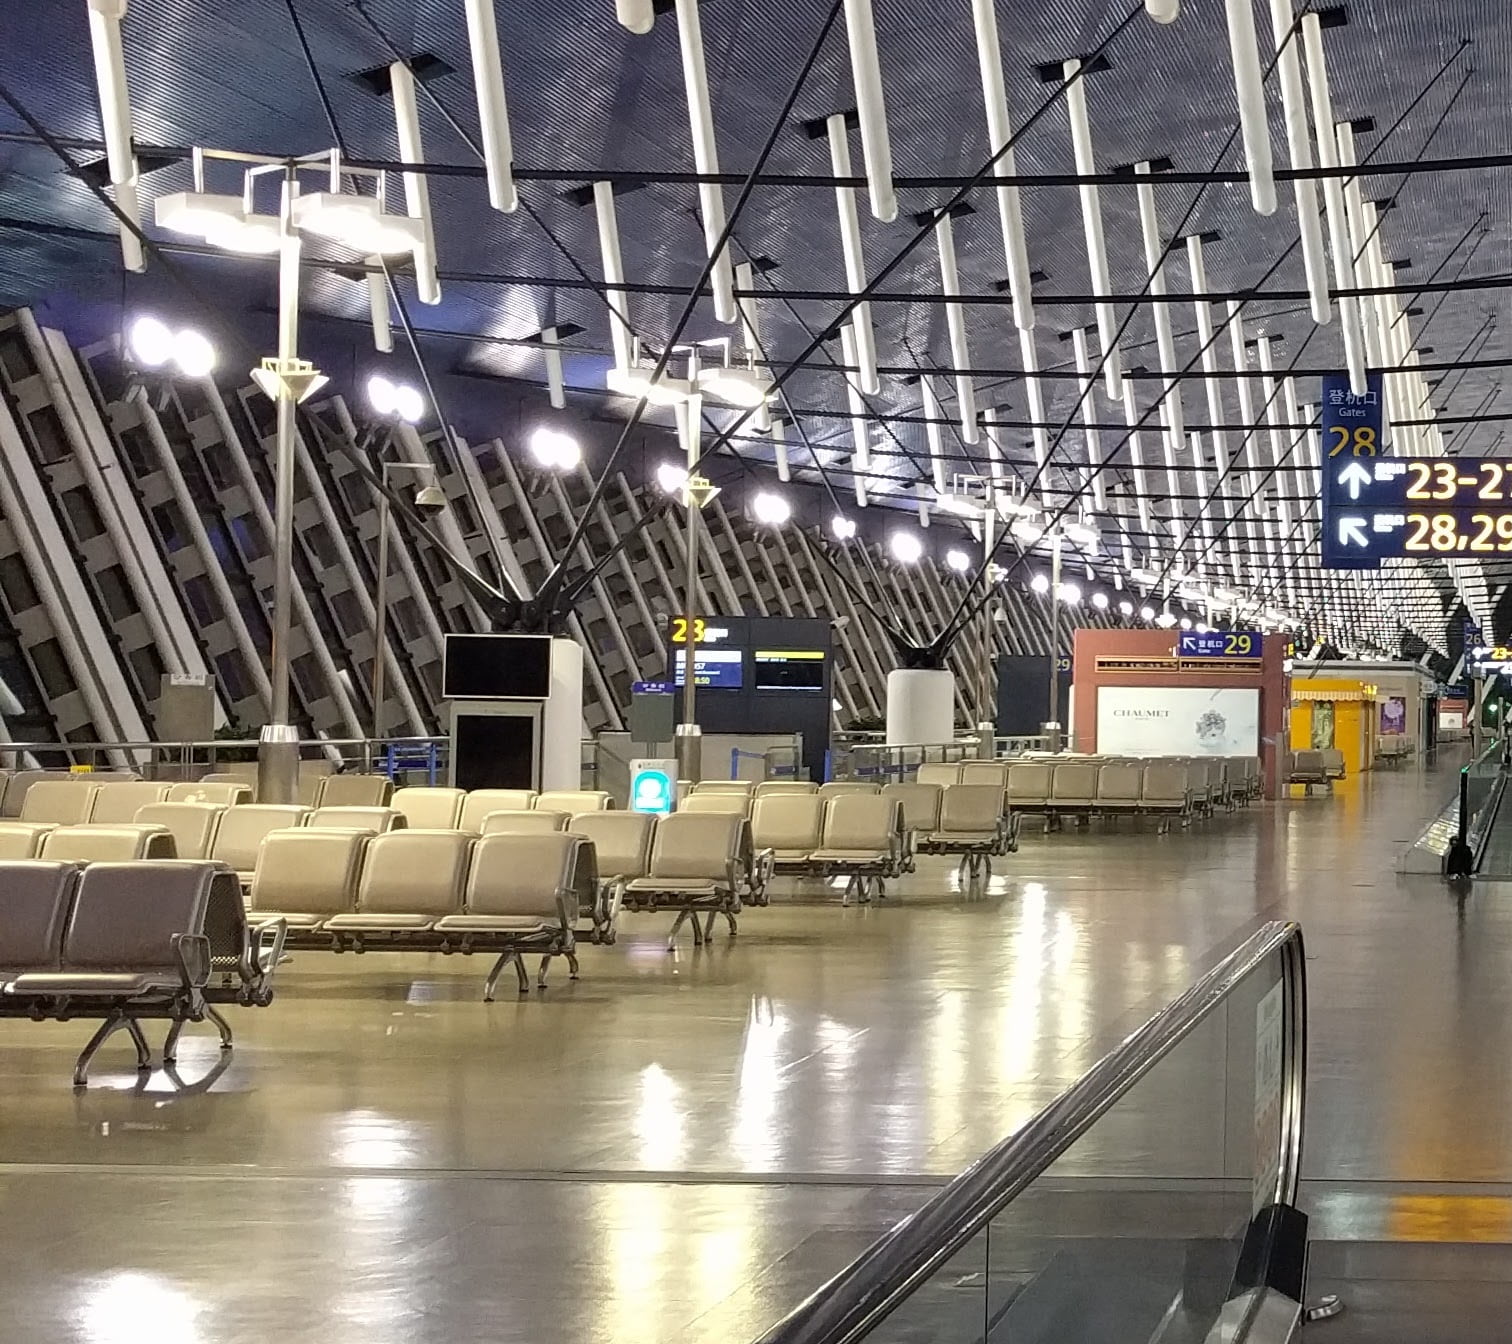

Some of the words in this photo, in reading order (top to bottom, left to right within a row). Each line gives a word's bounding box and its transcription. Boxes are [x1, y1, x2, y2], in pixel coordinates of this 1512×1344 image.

[1329, 389, 1377, 405] 登机口
[1339, 408, 1366, 417] Gates
[1328, 426, 1376, 456] 28
[1224, 634, 1252, 654] 29
[1113, 709, 1169, 717] CHAUMET
